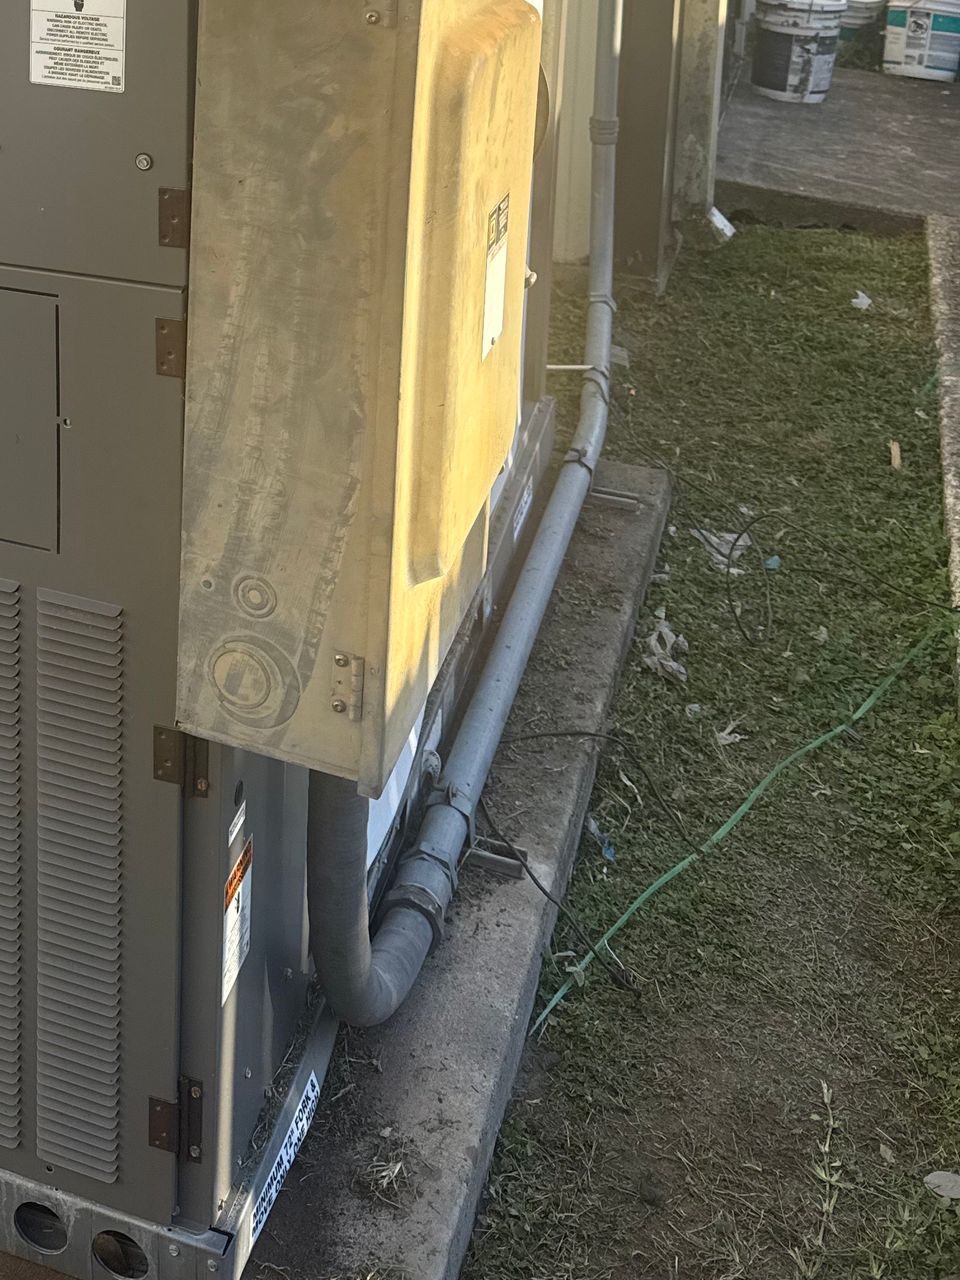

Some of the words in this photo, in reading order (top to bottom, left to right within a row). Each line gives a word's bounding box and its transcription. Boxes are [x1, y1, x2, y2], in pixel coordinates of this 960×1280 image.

[252, 1192, 273, 1238] MOVE
[293, 1124, 306, 1155] ONE
[253, 1153, 284, 1220] MINIMUM
[294, 1090, 311, 1131] FORK
